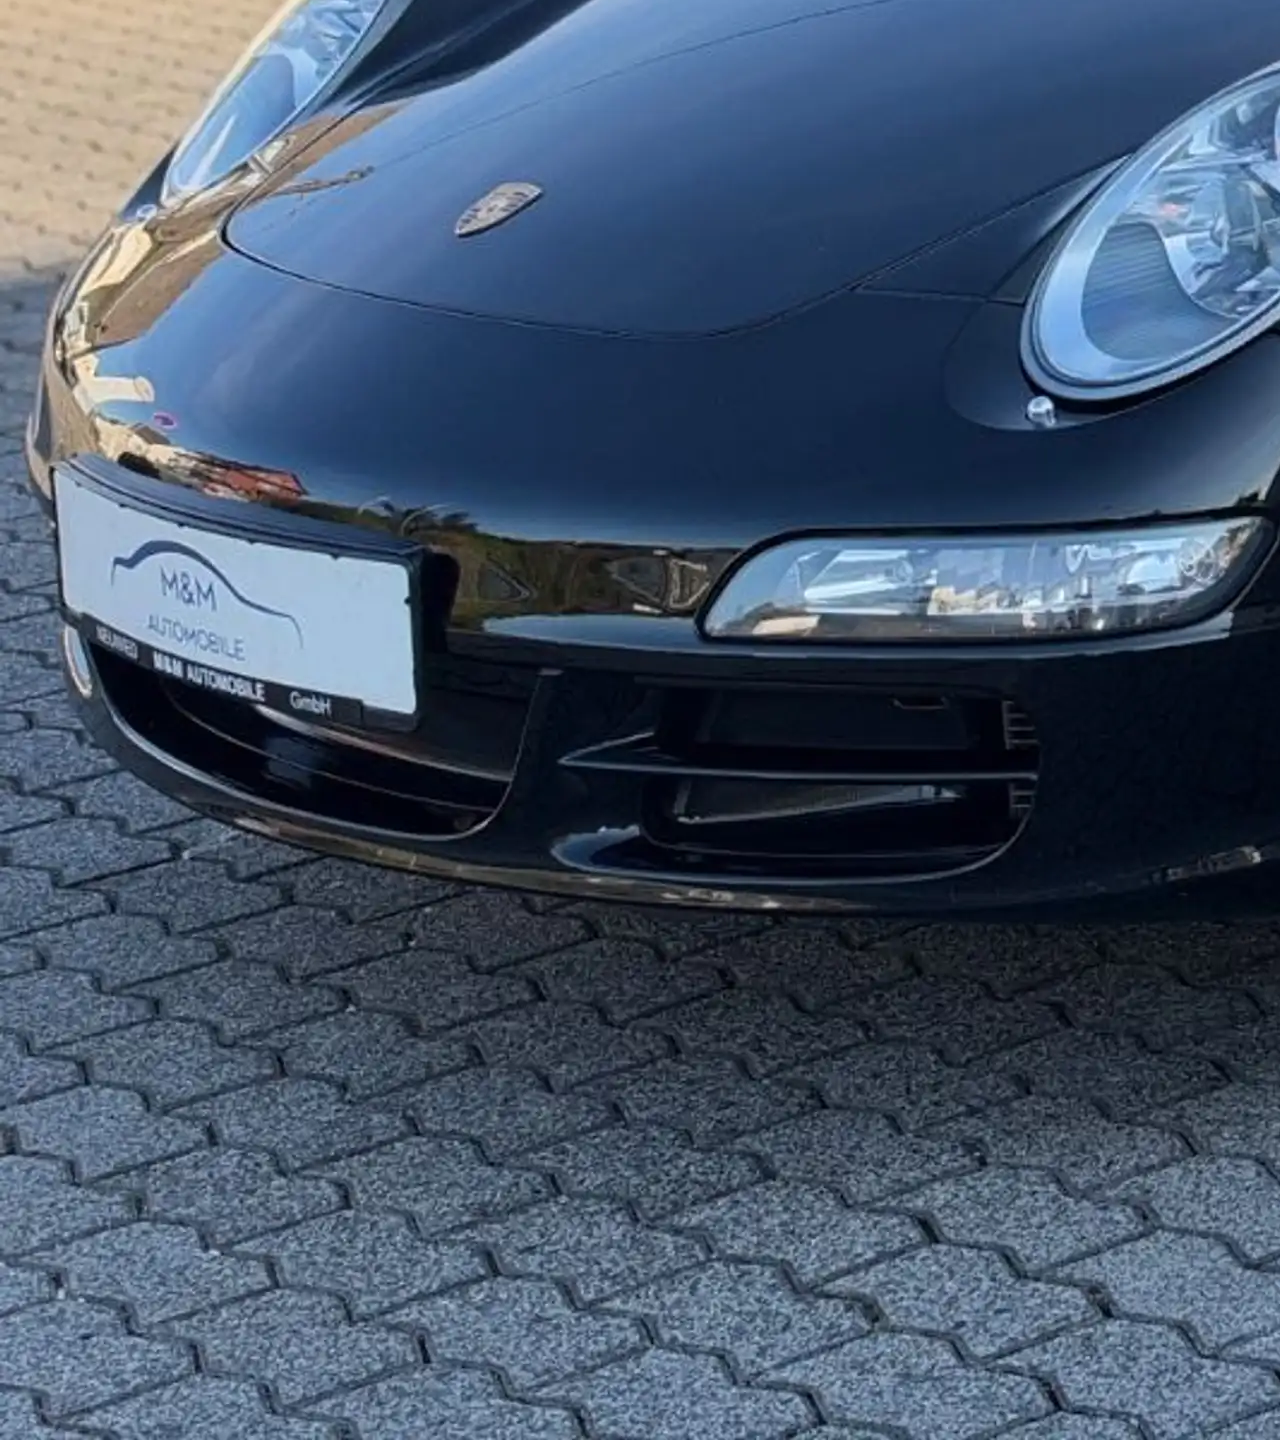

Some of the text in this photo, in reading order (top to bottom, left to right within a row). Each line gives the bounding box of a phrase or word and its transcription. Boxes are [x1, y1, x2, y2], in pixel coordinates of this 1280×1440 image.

[159, 564, 217, 611] M&M
[147, 613, 246, 661] AUTOMOBILE
[186, 663, 266, 703] AUTOMOBILE
[288, 690, 332, 717] GmbH
